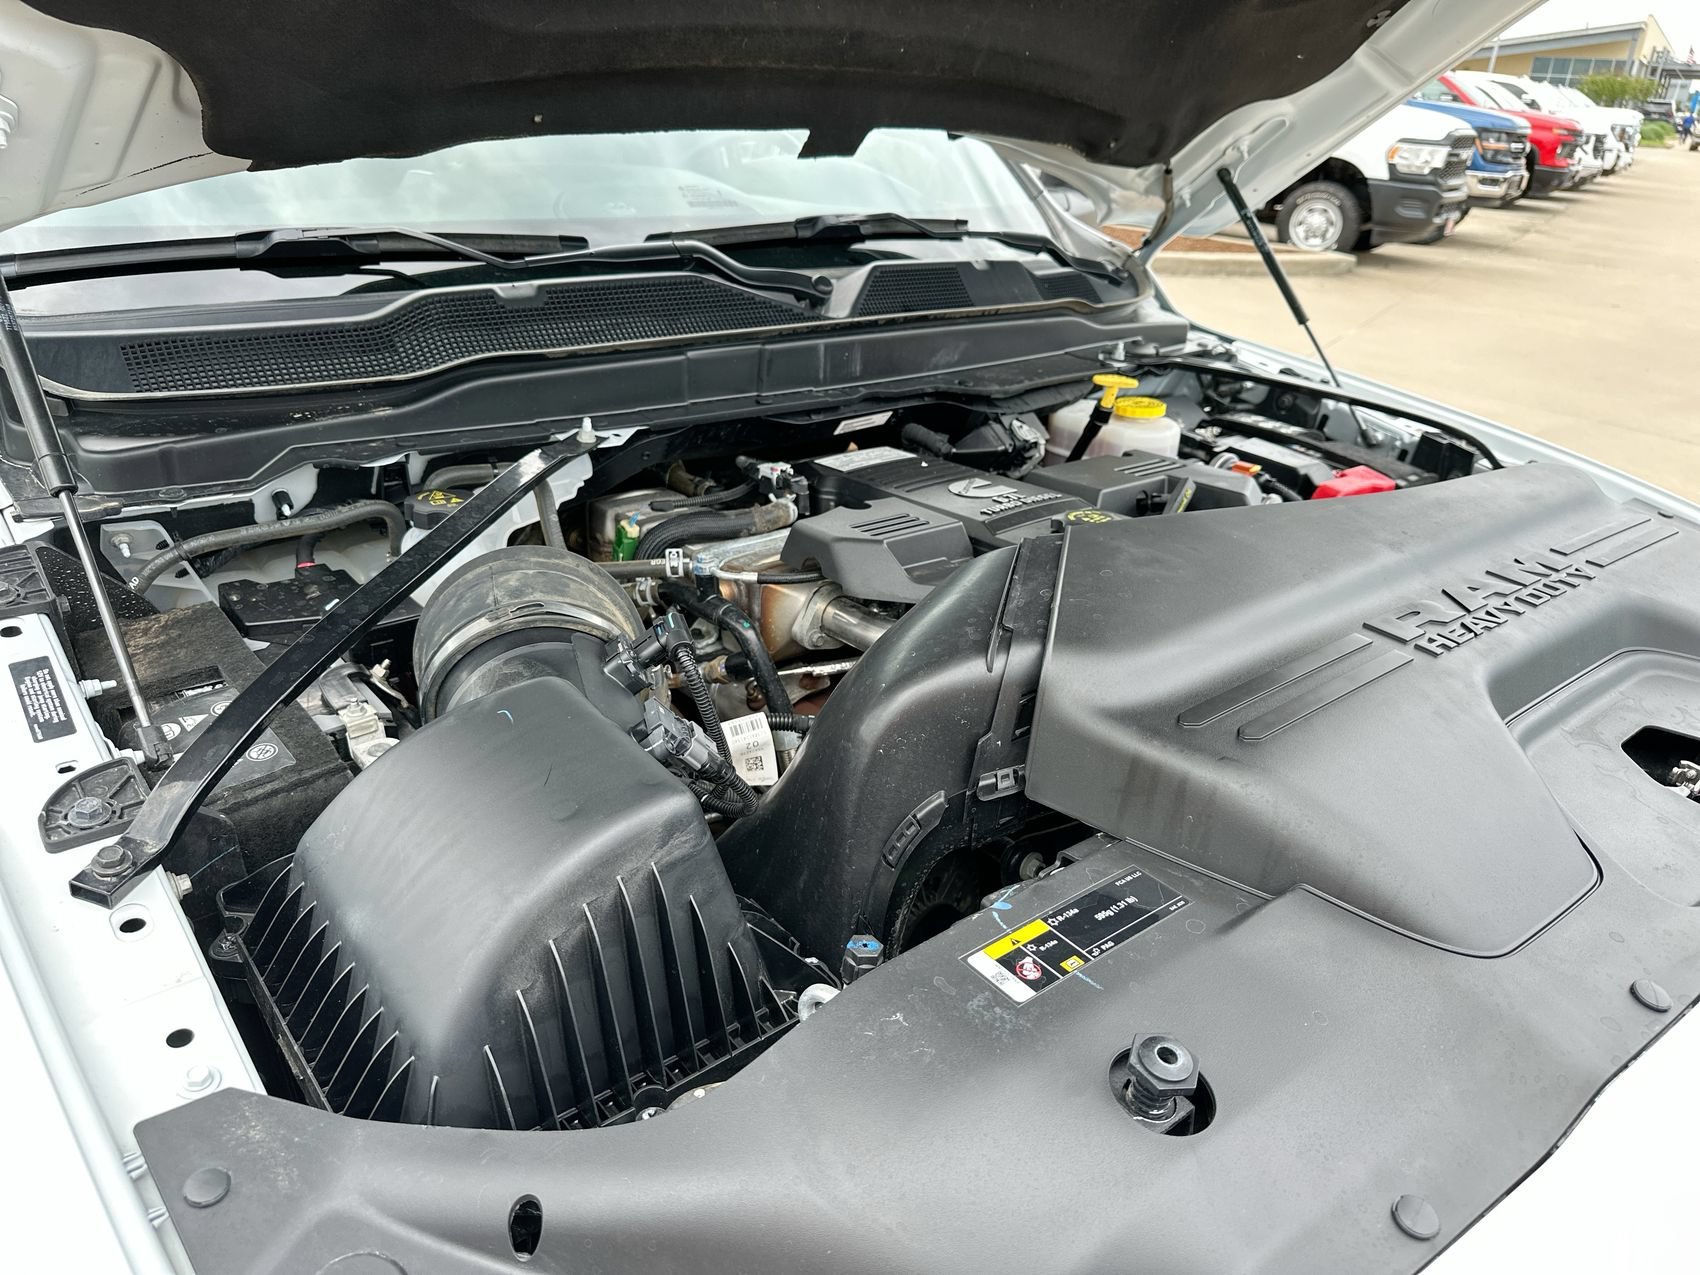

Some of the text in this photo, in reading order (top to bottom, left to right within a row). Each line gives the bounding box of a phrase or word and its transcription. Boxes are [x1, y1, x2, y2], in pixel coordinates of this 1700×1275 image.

[980, 501, 1022, 515] TURBO
[1362, 551, 1575, 644] RAM
[1414, 566, 1597, 657] HEAVY DUTY
[1102, 941, 1115, 951] PAG
